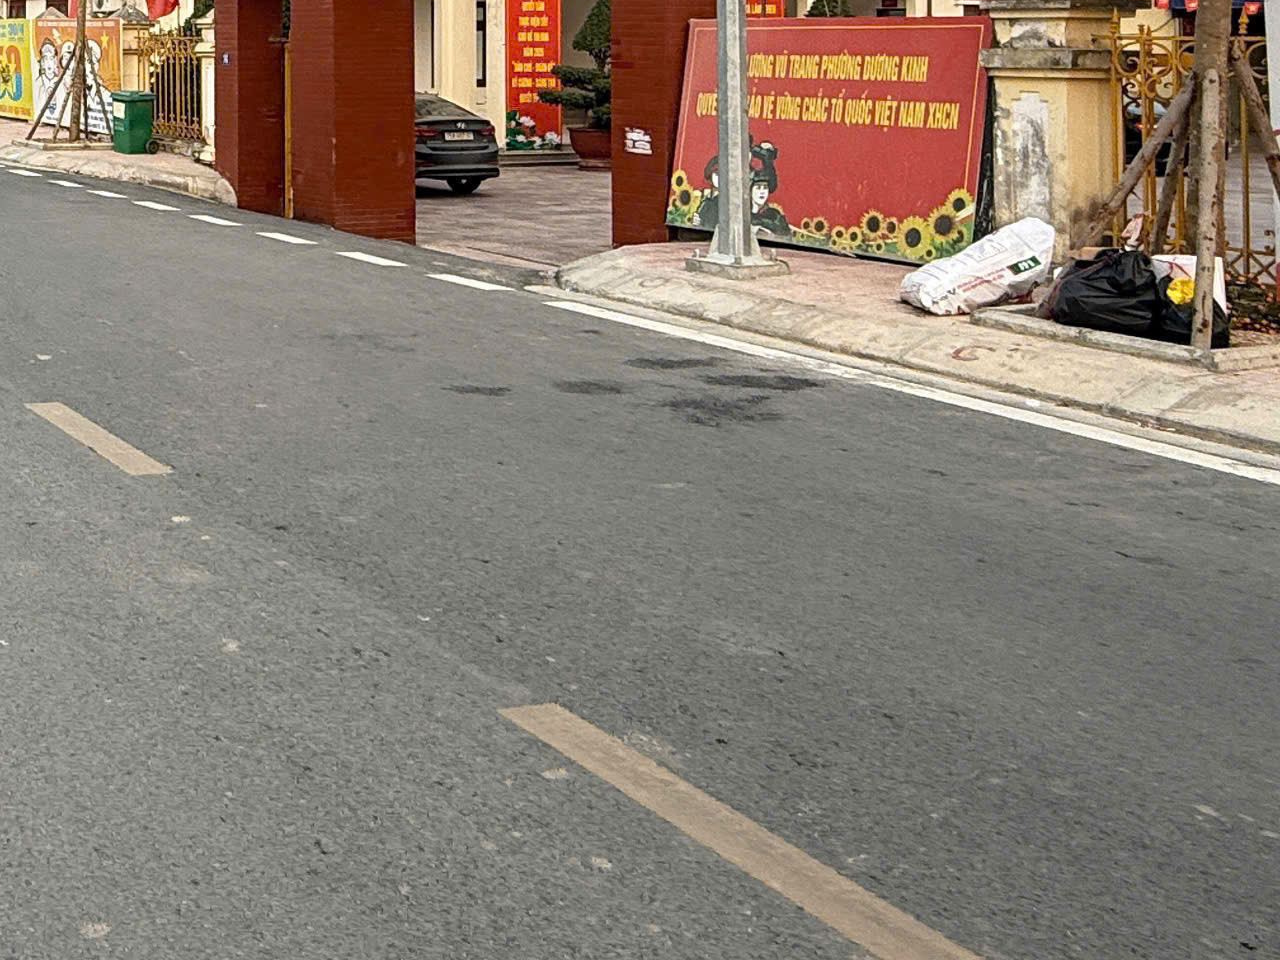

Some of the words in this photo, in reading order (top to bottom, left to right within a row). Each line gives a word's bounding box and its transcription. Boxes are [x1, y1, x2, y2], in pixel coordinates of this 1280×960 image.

[775, 49, 788, 79] VŨ
[788, 54, 820, 79] TRANG
[820, 48, 862, 81] PHƯỜNG
[862, 53, 900, 81] DƯƠNG
[900, 55, 929, 82] KINH
[762, 90, 776, 125] VỆ
[776, 91, 801, 121] VỮNG
[801, 87, 829, 122] CHẮC
[830, 88, 846, 124] TỔ
[844, 89, 873, 127] QUỐC
[873, 94, 898, 132] VIỆT
[898, 101, 926, 128] NAM
[926, 102, 960, 130] XHCN
